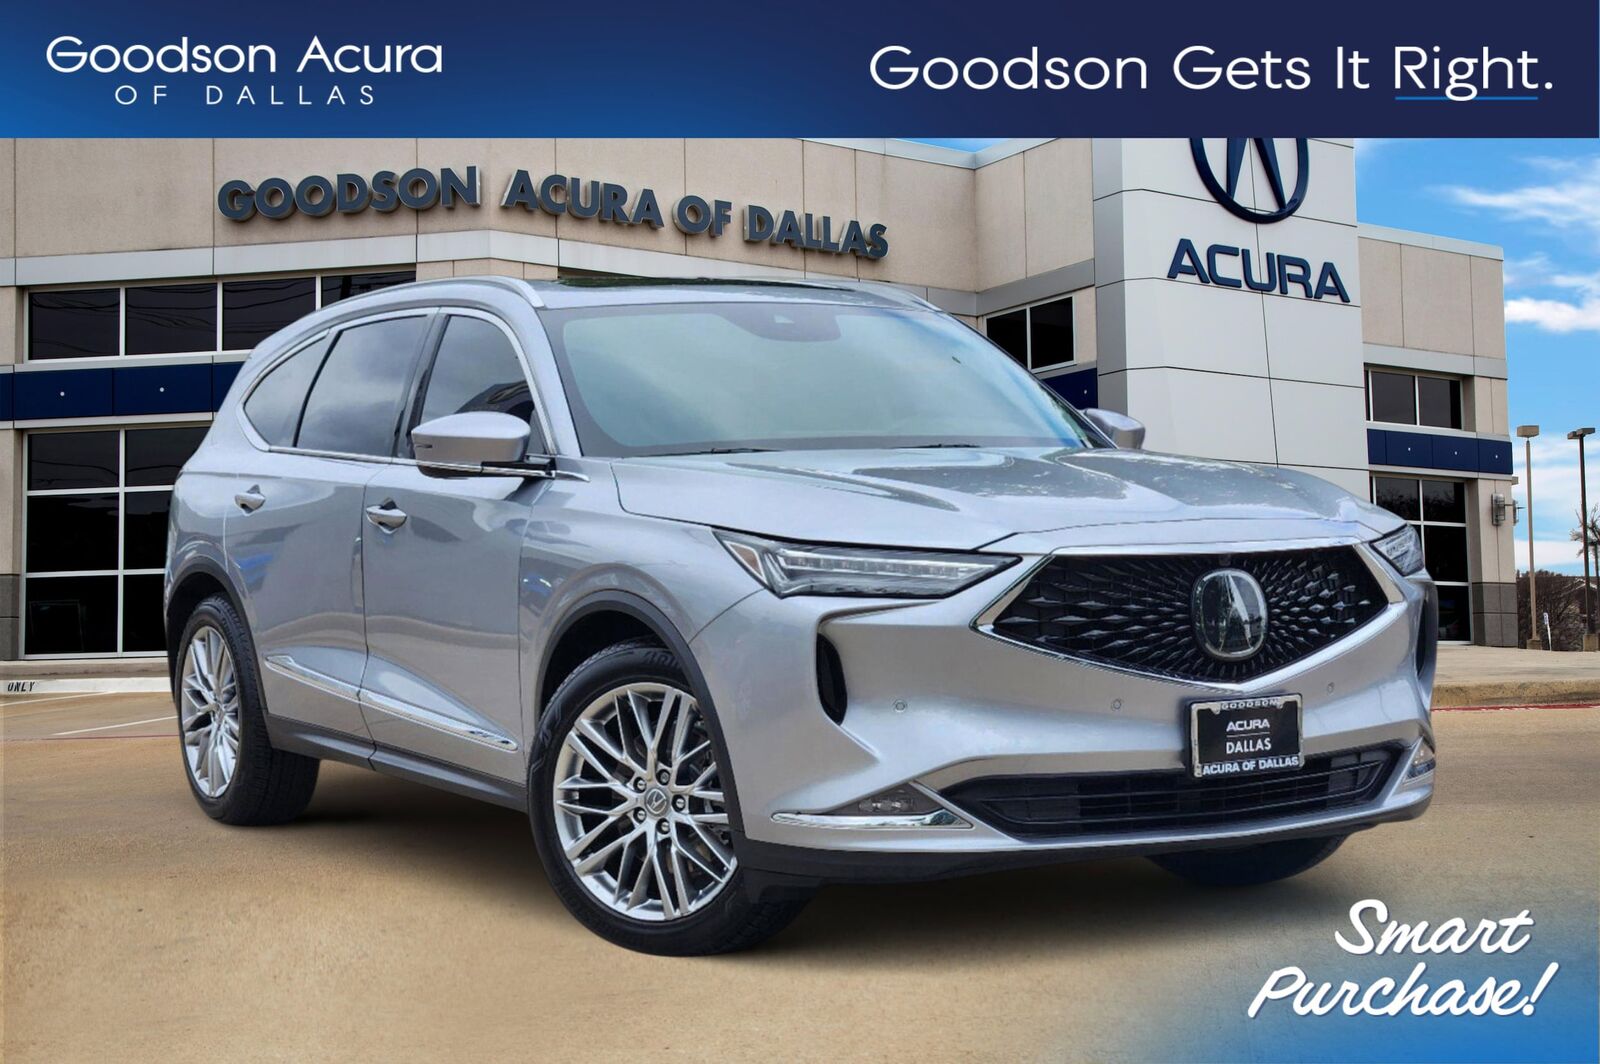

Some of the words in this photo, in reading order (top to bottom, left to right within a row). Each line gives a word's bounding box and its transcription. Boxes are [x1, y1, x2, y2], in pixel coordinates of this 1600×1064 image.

[217, 165, 481, 222] GOODSON
[500, 169, 665, 230] ACURA
[674, 194, 732, 236] OF
[744, 203, 889, 260] DALLAS
[1167, 237, 1350, 303] ACURA
[7, 681, 35, 692] ONLY
[1221, 698, 1280, 710] GOODSON
[1226, 719, 1270, 732] ACURA
[1226, 737, 1272, 754] DALLAS
[1202, 762, 1240, 776] ACURA
[1242, 760, 1256, 772] OF
[1259, 756, 1299, 769] DALLAS
